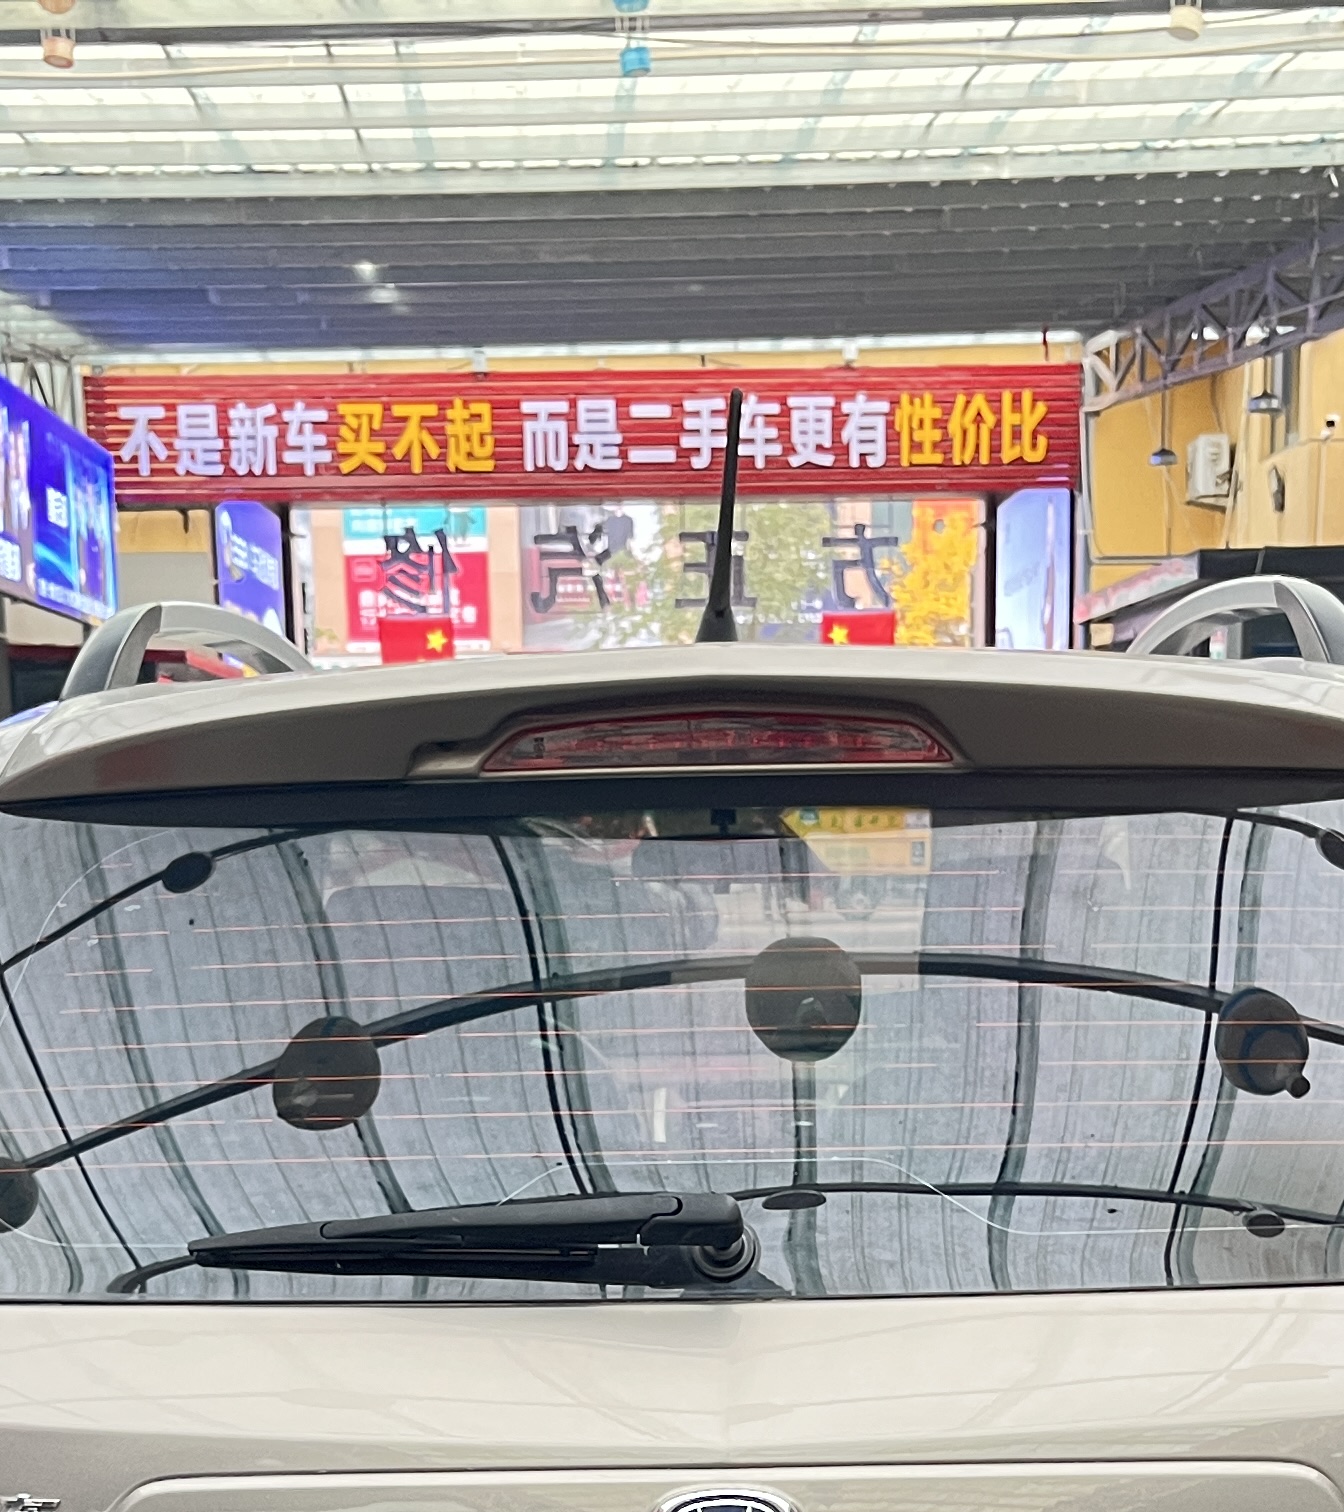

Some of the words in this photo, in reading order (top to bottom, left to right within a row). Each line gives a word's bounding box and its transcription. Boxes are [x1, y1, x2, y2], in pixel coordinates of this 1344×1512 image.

[117, 399, 497, 477] 不是新车买不起
[520, 388, 1049, 472] 而是二手车更有性价比
